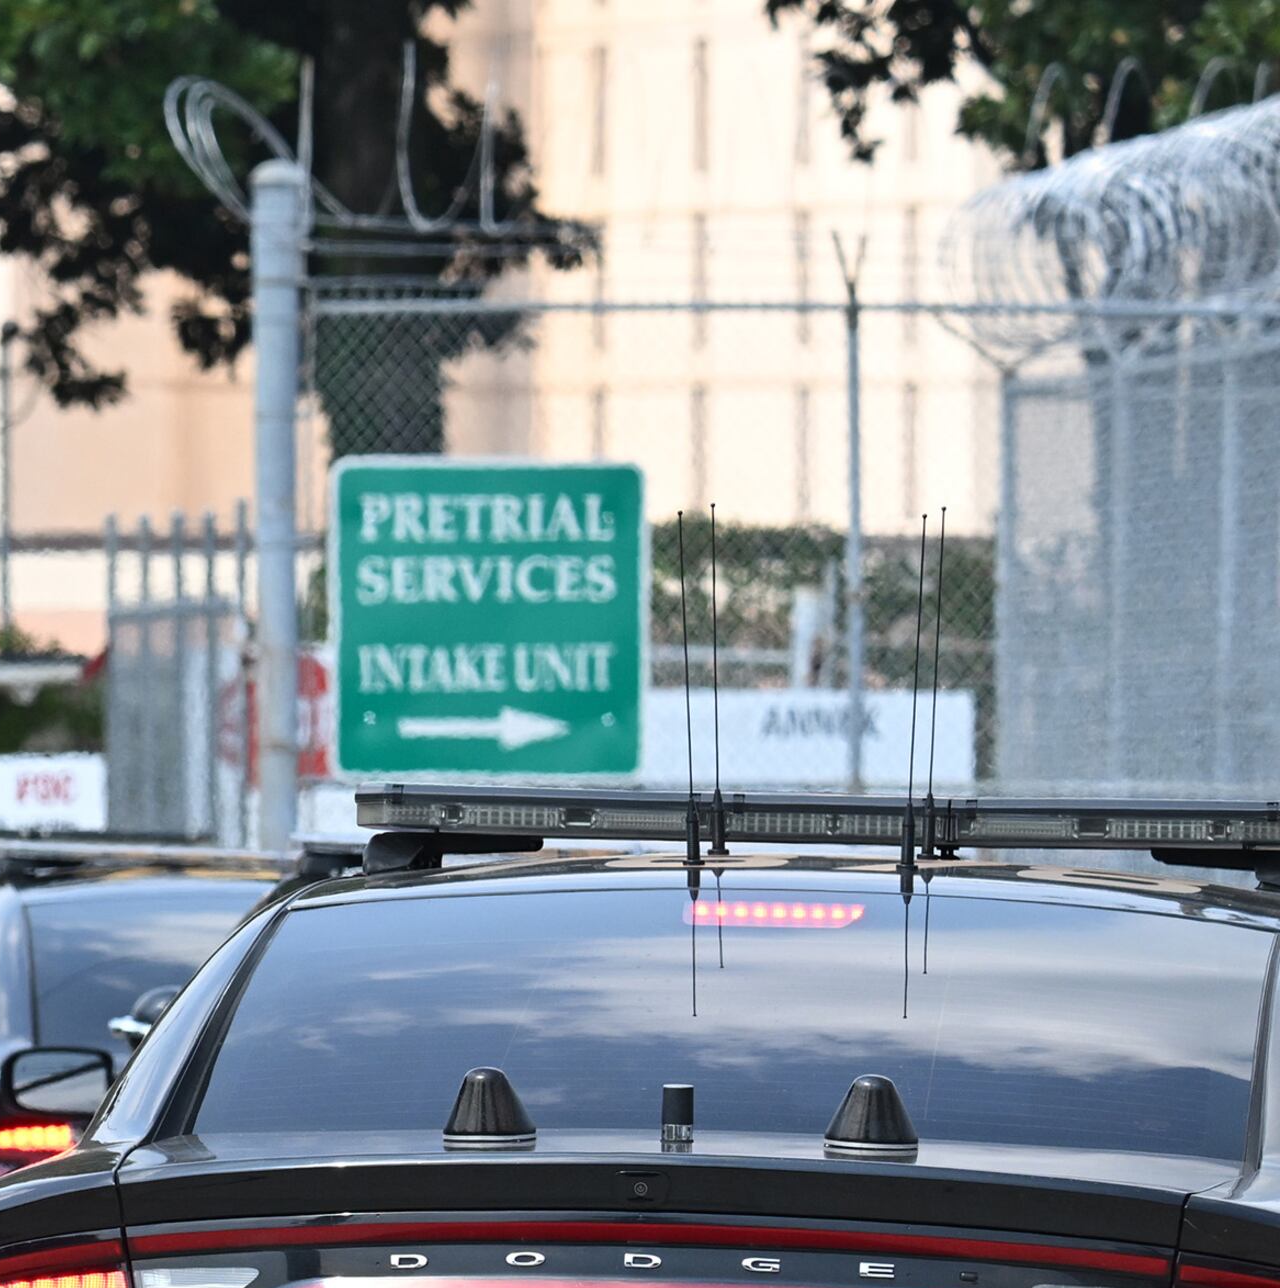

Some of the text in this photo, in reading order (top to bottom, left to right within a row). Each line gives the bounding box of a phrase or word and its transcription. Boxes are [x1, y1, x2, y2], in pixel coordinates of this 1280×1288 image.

[359, 492, 616, 543] PRETRIAL
[356, 553, 617, 606] SERVICES
[357, 641, 618, 694] INTAKE UNIT
[389, 1250, 896, 1280] DODGE
